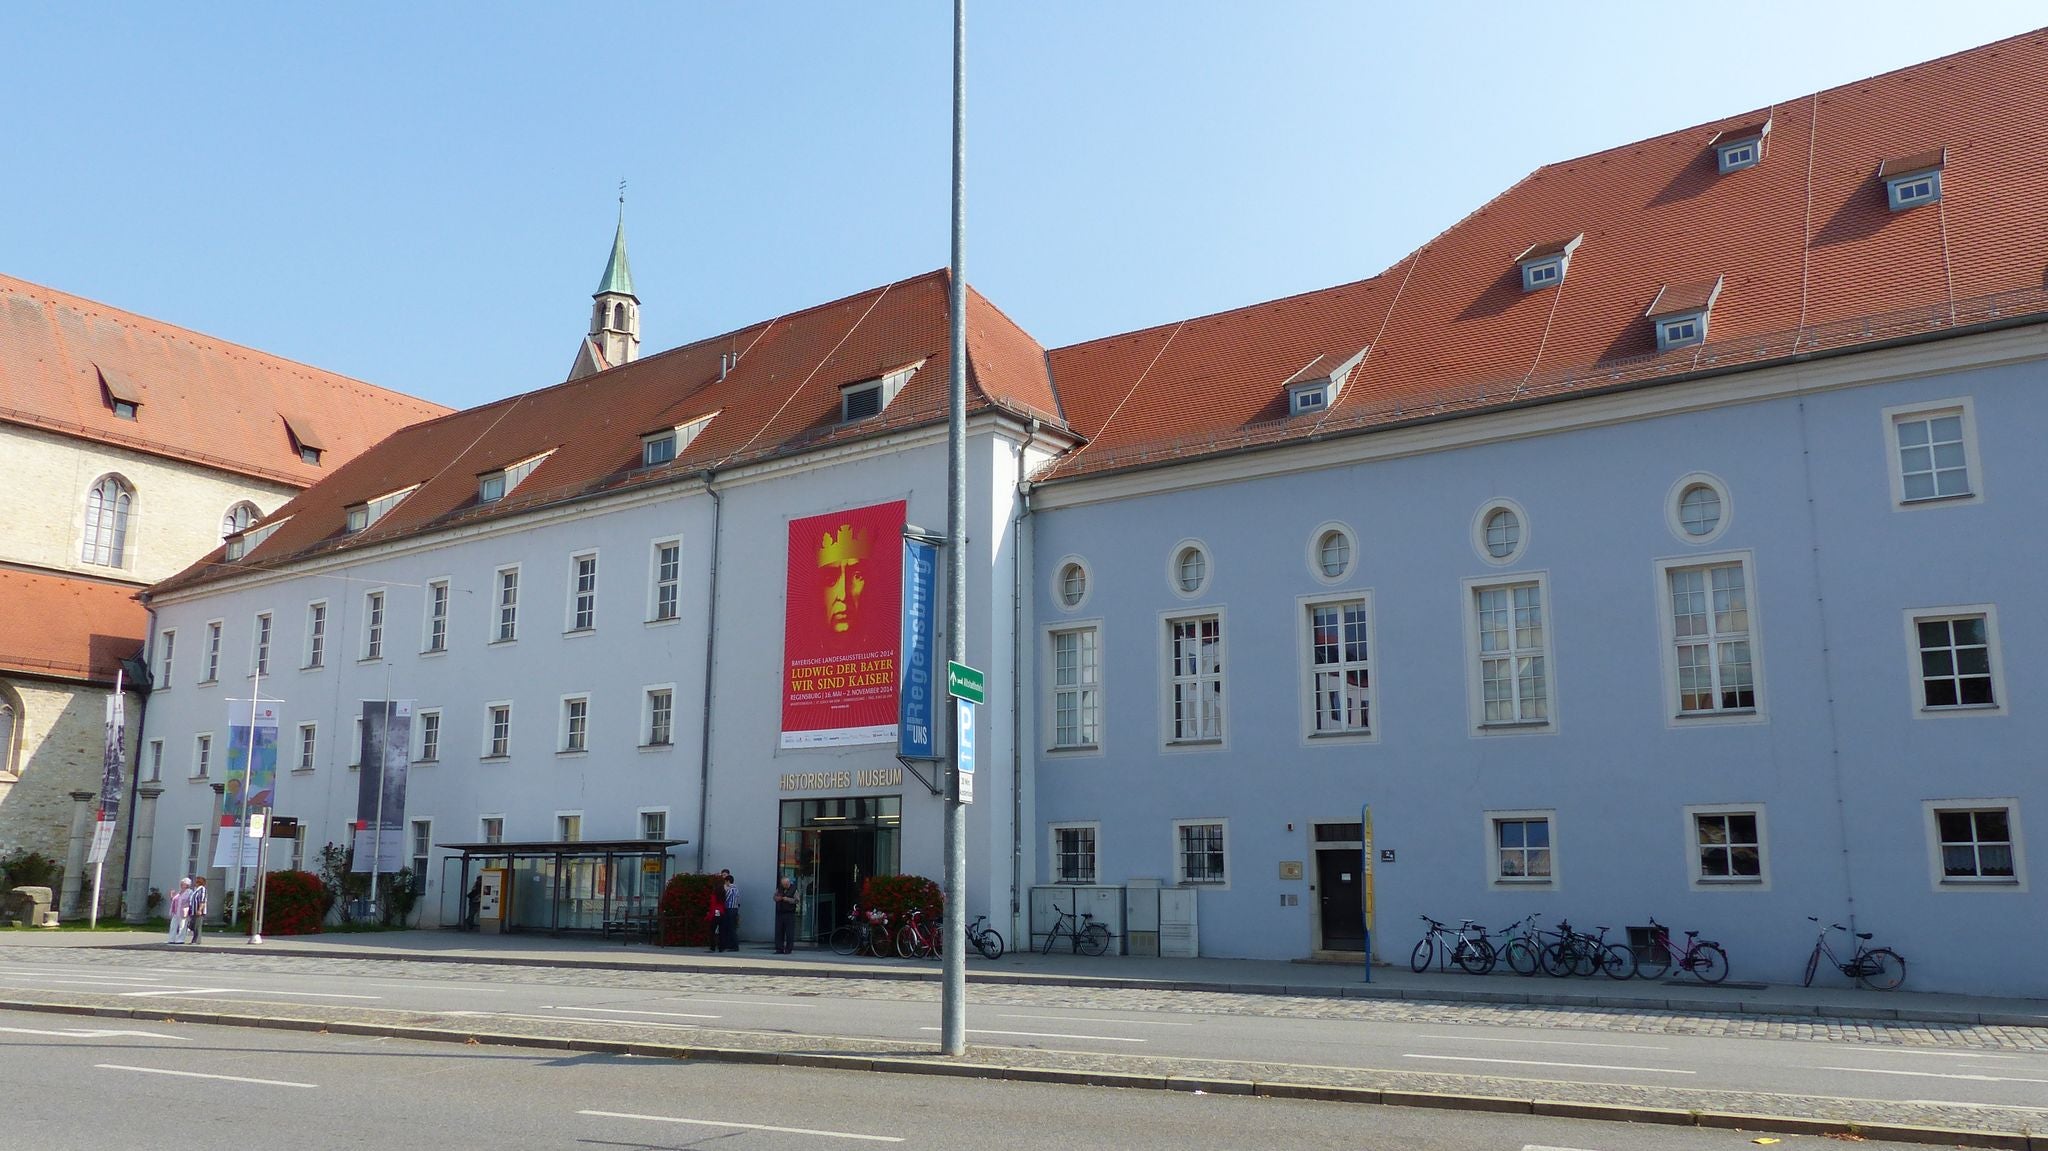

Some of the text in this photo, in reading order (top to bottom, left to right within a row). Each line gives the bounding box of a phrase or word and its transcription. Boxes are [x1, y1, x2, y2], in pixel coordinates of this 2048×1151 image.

[907, 559, 931, 717] Regensburg
[791, 658, 822, 667] BAYERISCHE
[822, 651, 879, 663] LANDESAUSSTELLUNG
[791, 659, 893, 679] LUDWIG DER BAYER
[792, 671, 894, 692] WIR SIND KAISER!
[790, 692, 821, 701] REGENSBURG
[852, 687, 879, 696] NOVEMBER
[913, 724, 927, 745] UNS
[961, 705, 972, 748] P
[780, 768, 903, 791] HISTORISCHES MUSEUM
